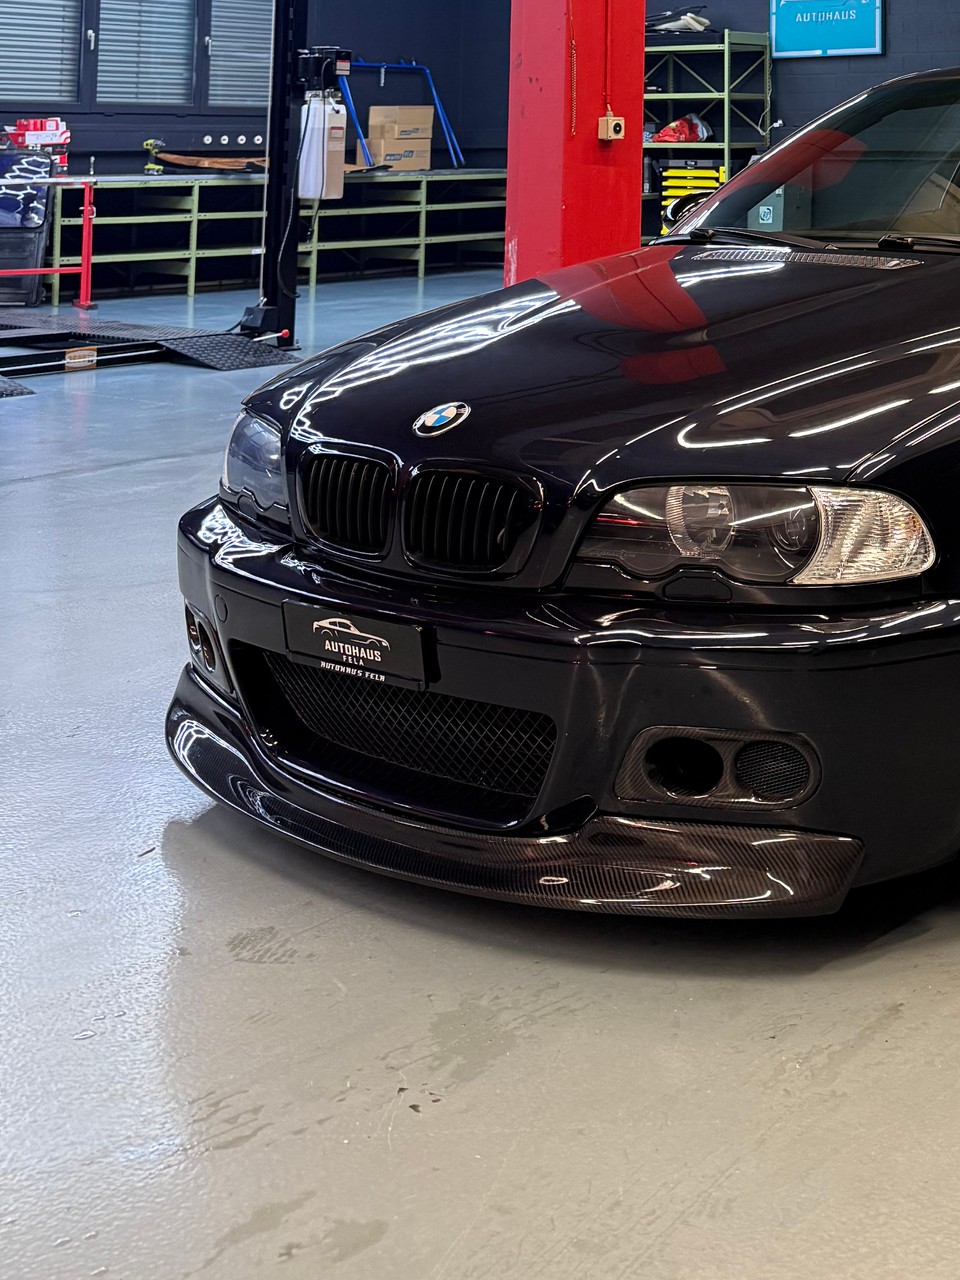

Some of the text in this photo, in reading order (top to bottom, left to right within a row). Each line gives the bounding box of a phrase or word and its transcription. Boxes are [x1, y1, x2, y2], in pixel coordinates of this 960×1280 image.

[795, 9, 856, 22] AUTOHAUS
[324, 639, 381, 661] AUTOHAUS
[342, 655, 364, 666] FELA
